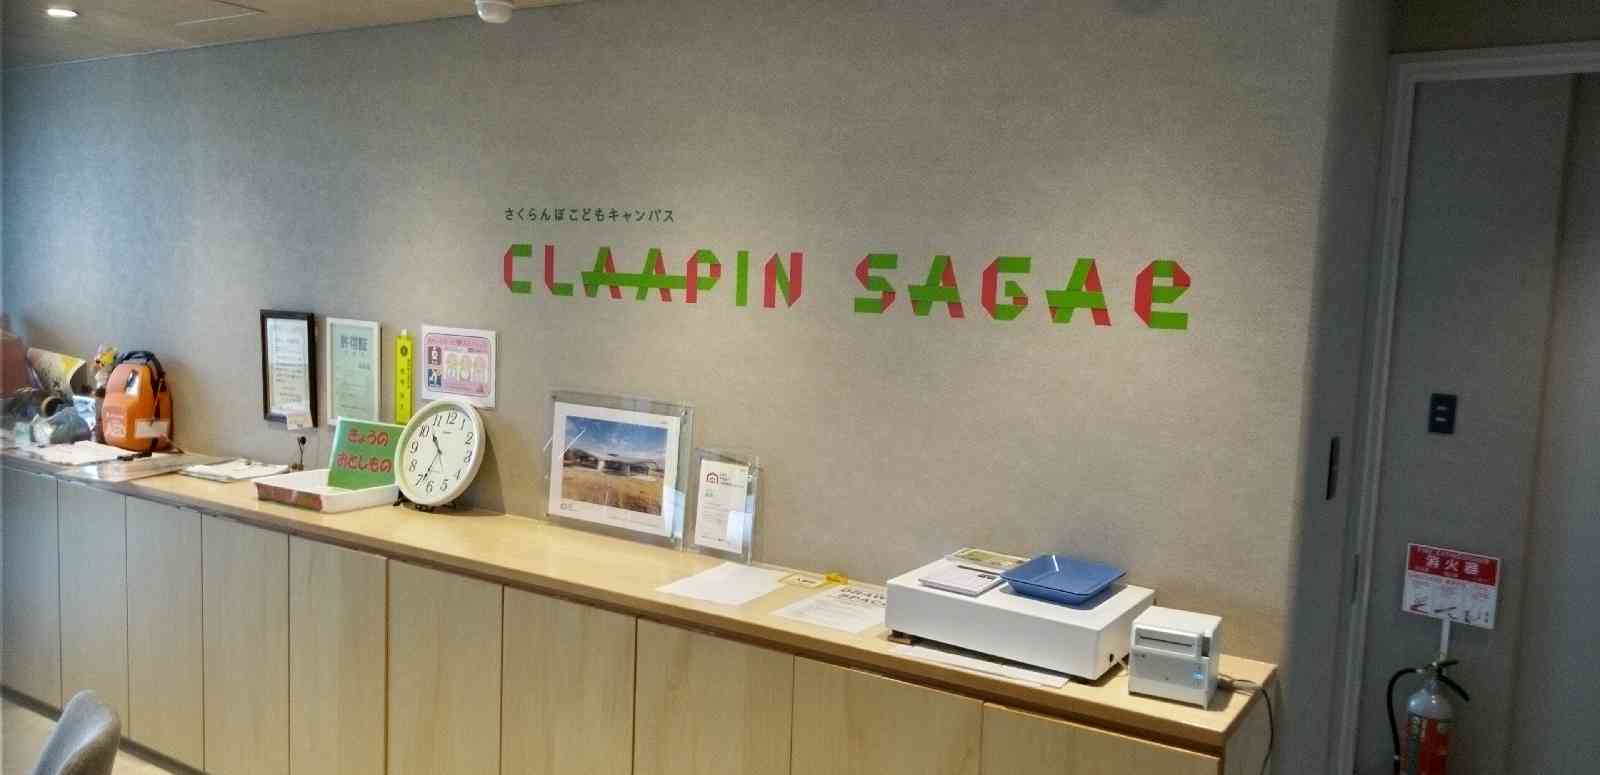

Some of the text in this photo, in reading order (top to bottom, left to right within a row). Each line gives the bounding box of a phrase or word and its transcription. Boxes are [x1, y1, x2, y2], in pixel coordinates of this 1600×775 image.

[504, 207, 674, 223] さくらんぼこどもキャンパス
[503, 244, 804, 309] CLAAPIN
[432, 414, 443, 427] 11
[446, 408, 458, 425] 12
[346, 428, 391, 447] きょうの
[419, 424, 431, 438] 10
[464, 431, 474, 446] 2
[409, 441, 419, 454] 9
[336, 451, 394, 473] おとしもの
[463, 449, 473, 464] 3
[408, 459, 418, 473] 8
[415, 473, 424, 487] 7
[426, 479, 435, 494] 6
[440, 479, 449, 492] 5
[1424, 554, 1480, 575] 消火器
